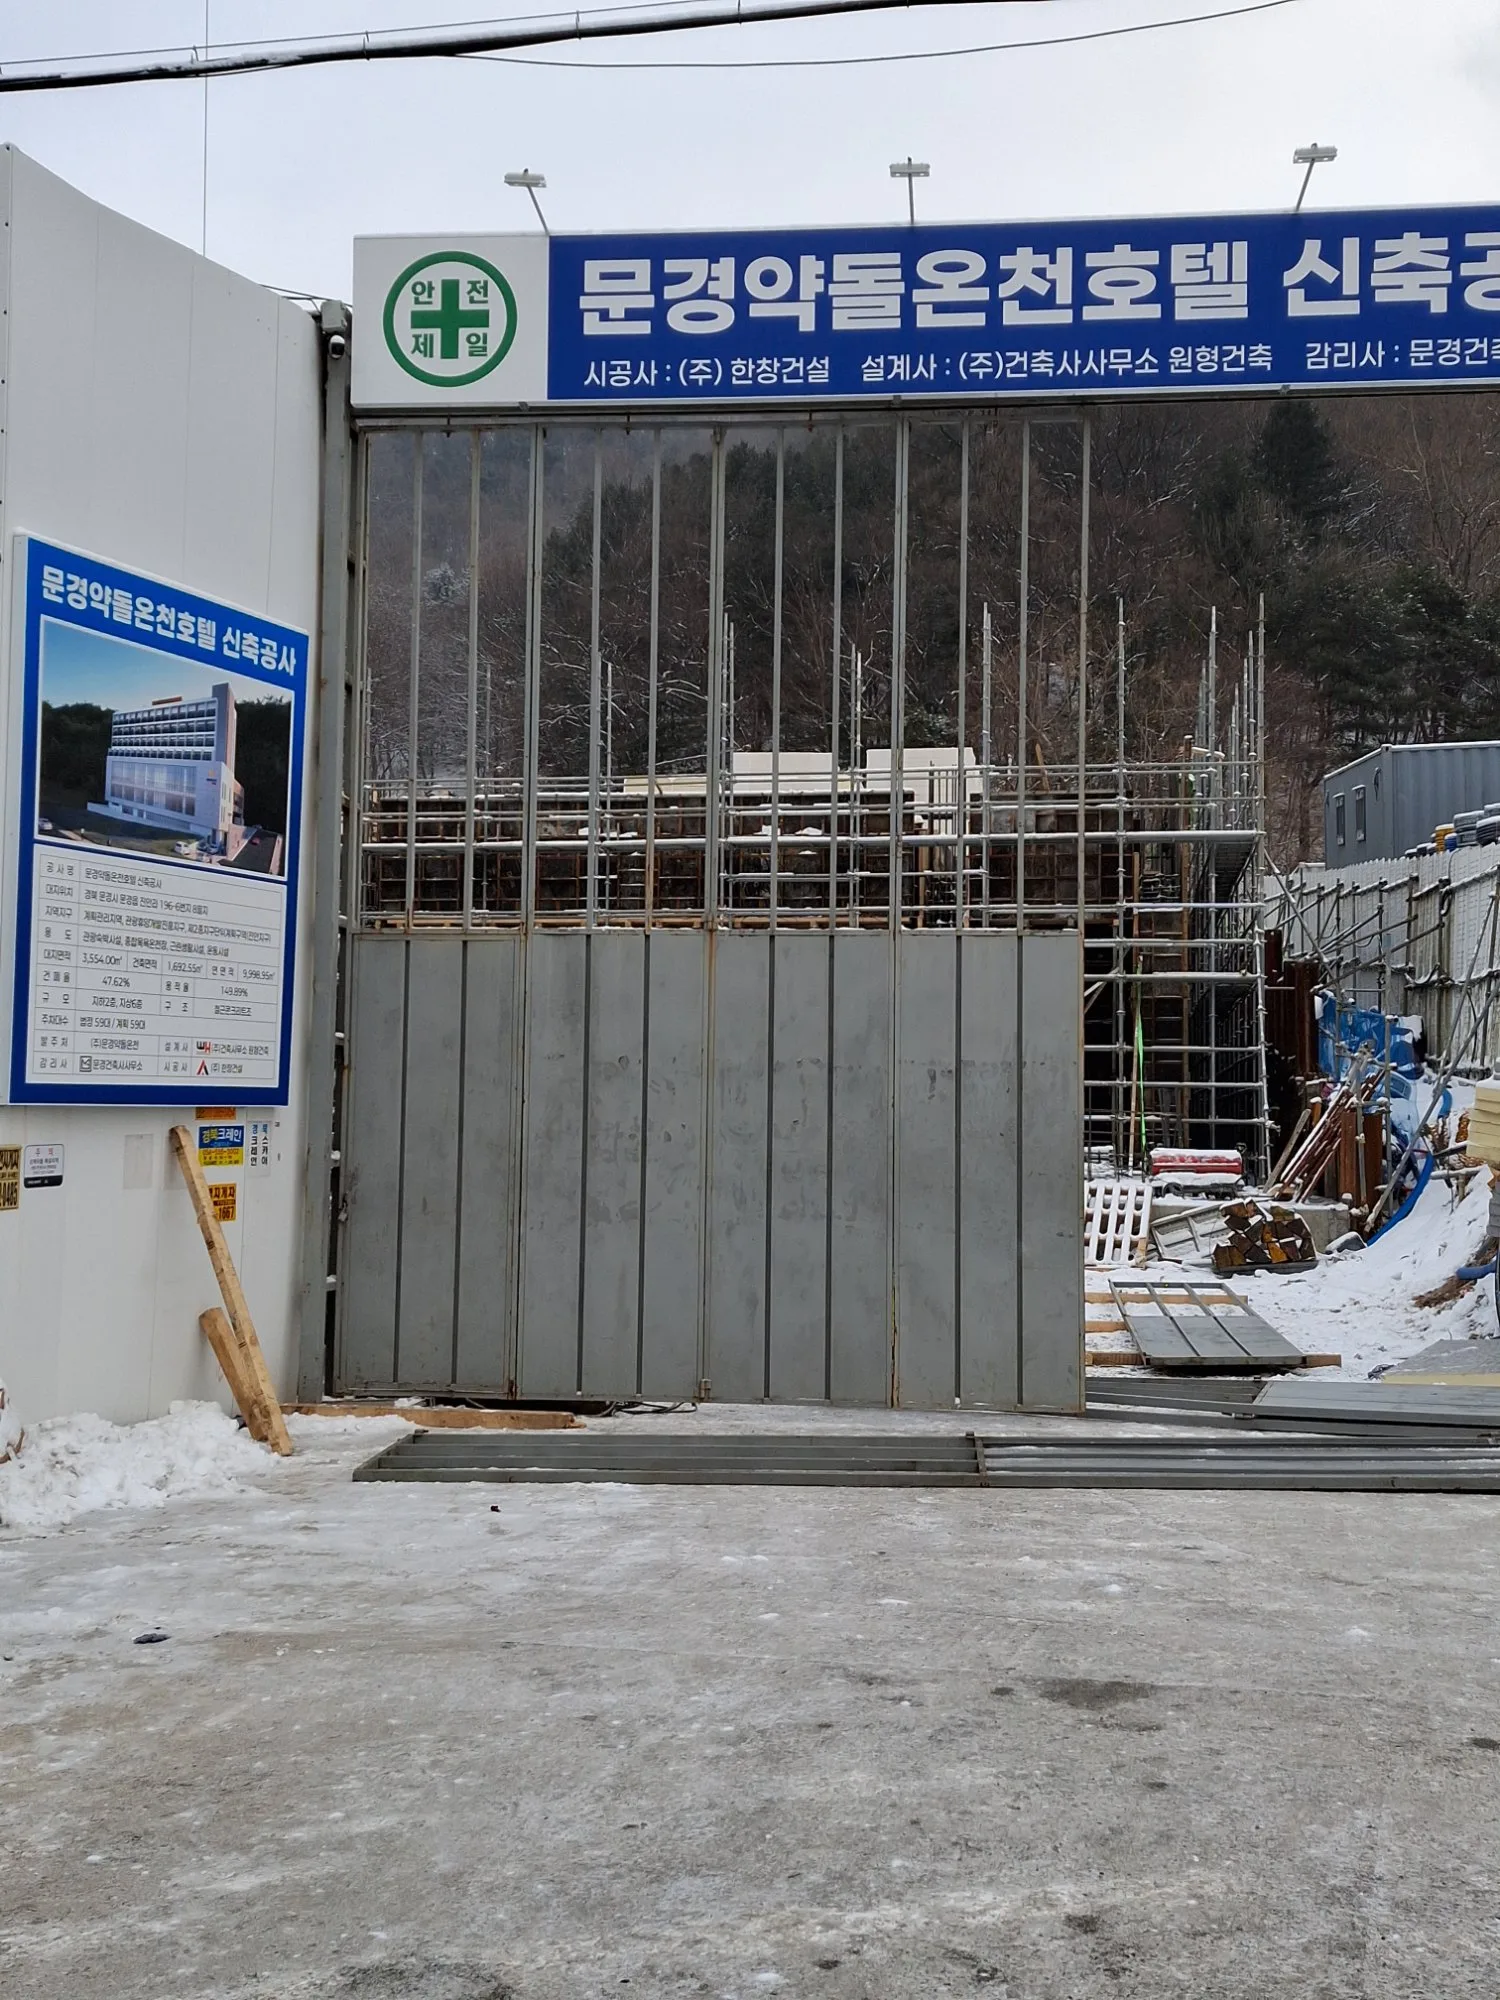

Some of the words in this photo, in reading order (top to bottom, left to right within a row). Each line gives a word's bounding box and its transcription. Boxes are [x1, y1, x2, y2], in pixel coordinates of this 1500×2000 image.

[579, 241, 1248, 336] 문경약돌온천호텔
[730, 355, 830, 385] 한창건설
[1168, 343, 1273, 373] 원형건축
[41, 565, 216, 652] 문경약돌온천호텔
[221, 626, 297, 677] 신축공사
[102, 975, 130, 988] 47.62%
